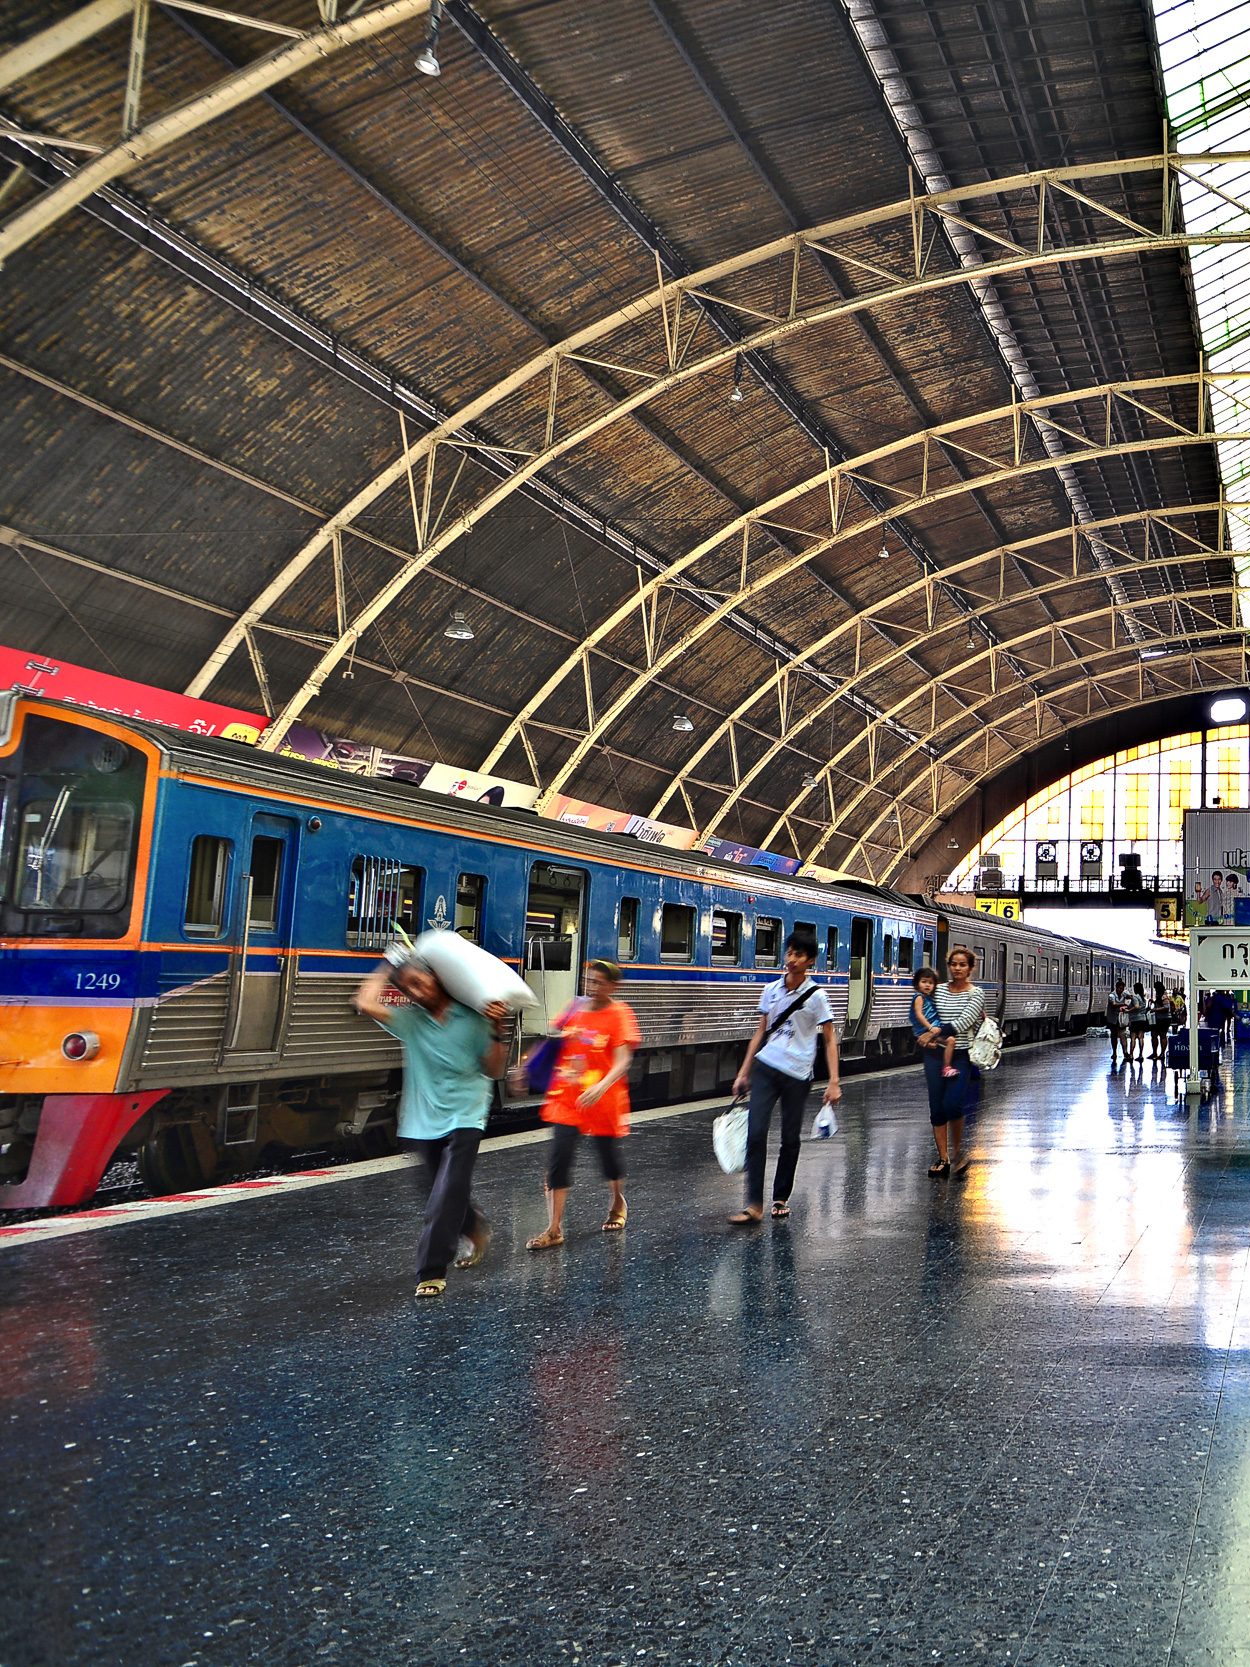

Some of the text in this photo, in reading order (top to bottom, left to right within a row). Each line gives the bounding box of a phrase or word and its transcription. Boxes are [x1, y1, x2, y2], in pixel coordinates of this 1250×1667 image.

[1003, 905, 1014, 919] 6
[1160, 904, 1171, 919] 5
[75, 973, 120, 990] 1249
